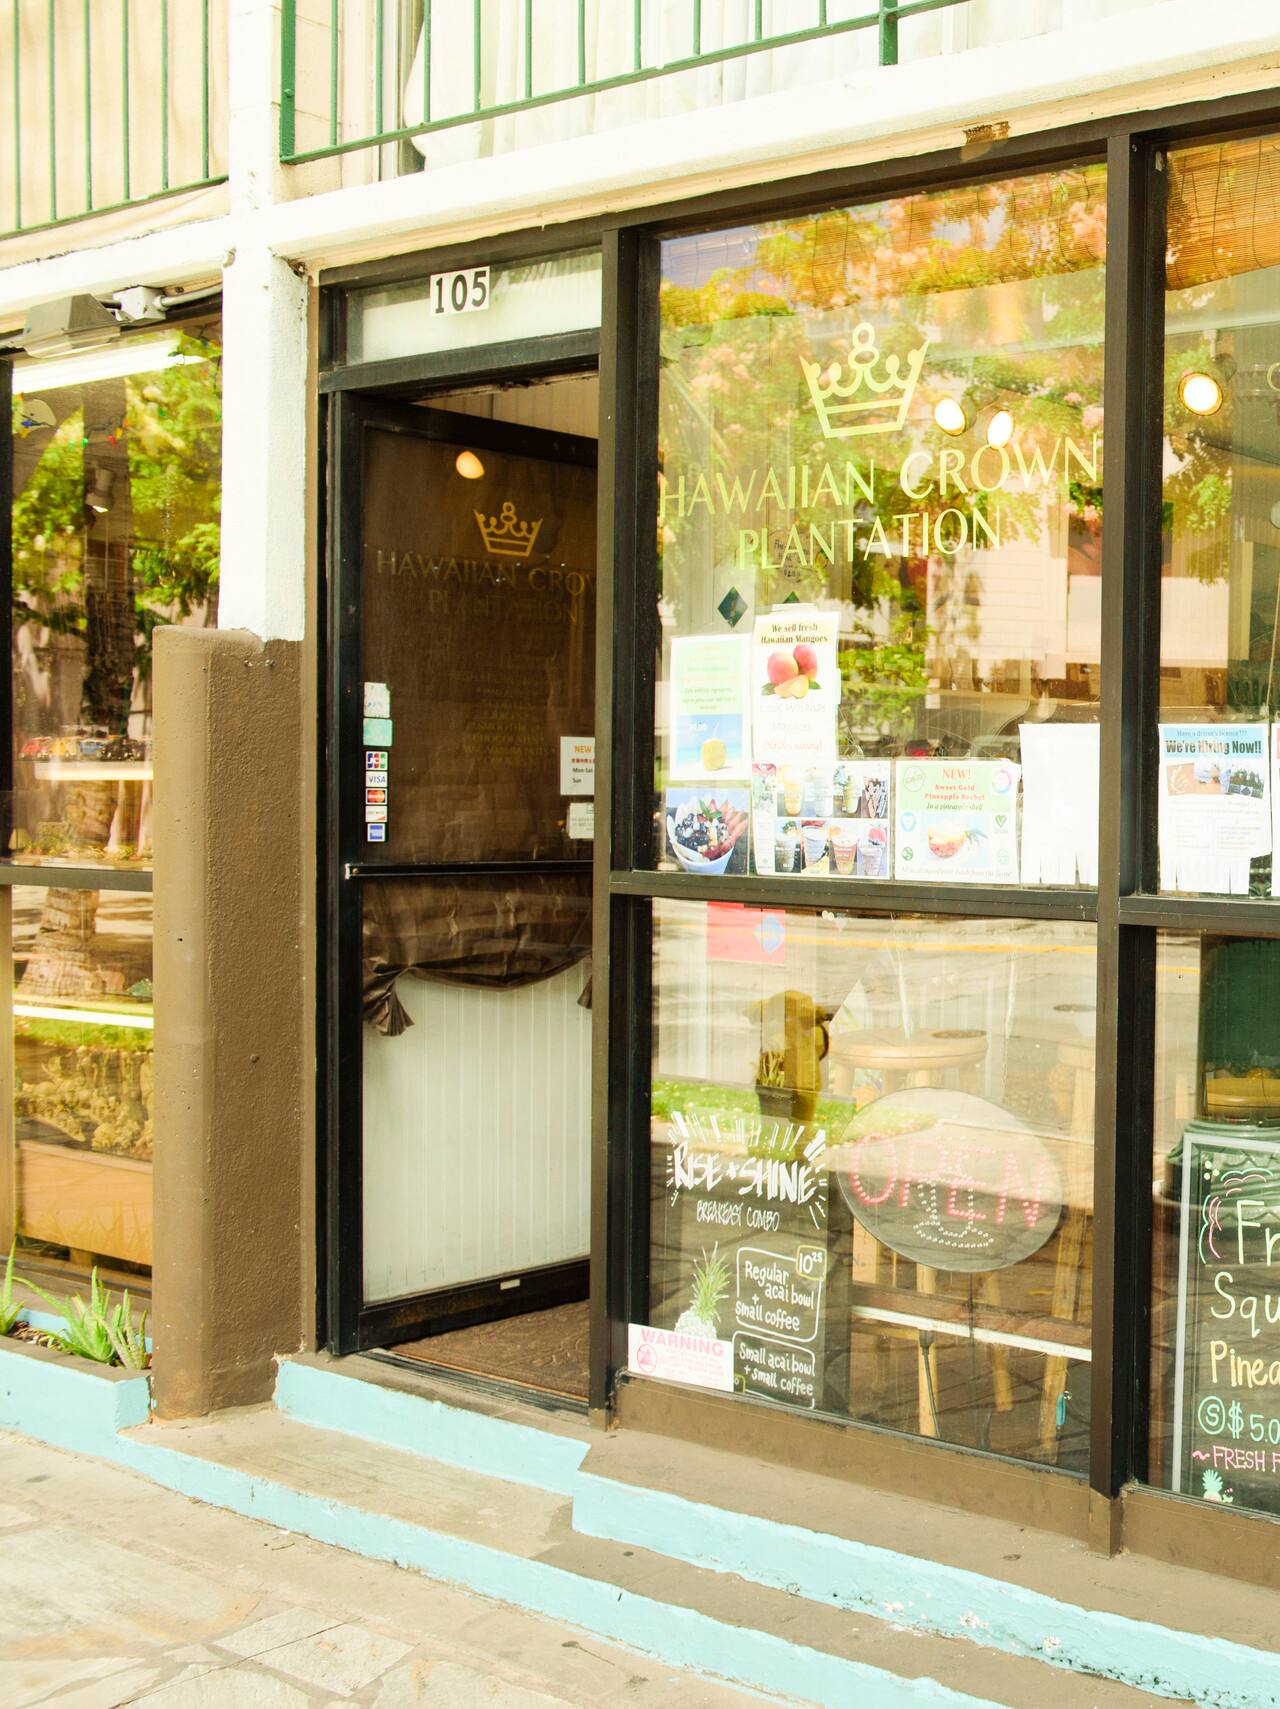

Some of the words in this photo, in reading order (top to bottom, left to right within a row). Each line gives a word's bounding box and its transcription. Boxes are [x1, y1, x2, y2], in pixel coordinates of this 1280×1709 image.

[434, 270, 487, 314] 105
[660, 459, 874, 518] HAWAIIAN
[901, 434, 1098, 499] CROWN
[738, 505, 1000, 570] PLANTATION
[376, 550, 516, 587] HAWAIIAN
[575, 745, 592, 753] NEW
[1166, 740, 1196, 753] We're
[1198, 740, 1230, 755] Hiring
[1232, 740, 1262, 754] Now!!
[368, 775, 386, 784] VISA
[942, 768, 971, 780] NEW!
[673, 1141, 723, 1192] RISE
[738, 1157, 817, 1205] SHINE
[851, 1132, 1047, 1229] OPEN
[746, 1206, 780, 1232] COMBO
[744, 1260, 789, 1287] Regular
[765, 1282, 789, 1303] acai
[791, 1284, 815, 1310] bowl
[735, 1300, 763, 1321] small
[764, 1308, 800, 1332] coffee
[641, 1327, 724, 1356] WARNING
[739, 1342, 766, 1365] Small
[767, 1353, 791, 1371] acai
[791, 1353, 816, 1377] bowl
[751, 1367, 777, 1388] small
[780, 1376, 814, 1396] coffee
[1212, 1444, 1266, 1472] FRESH
